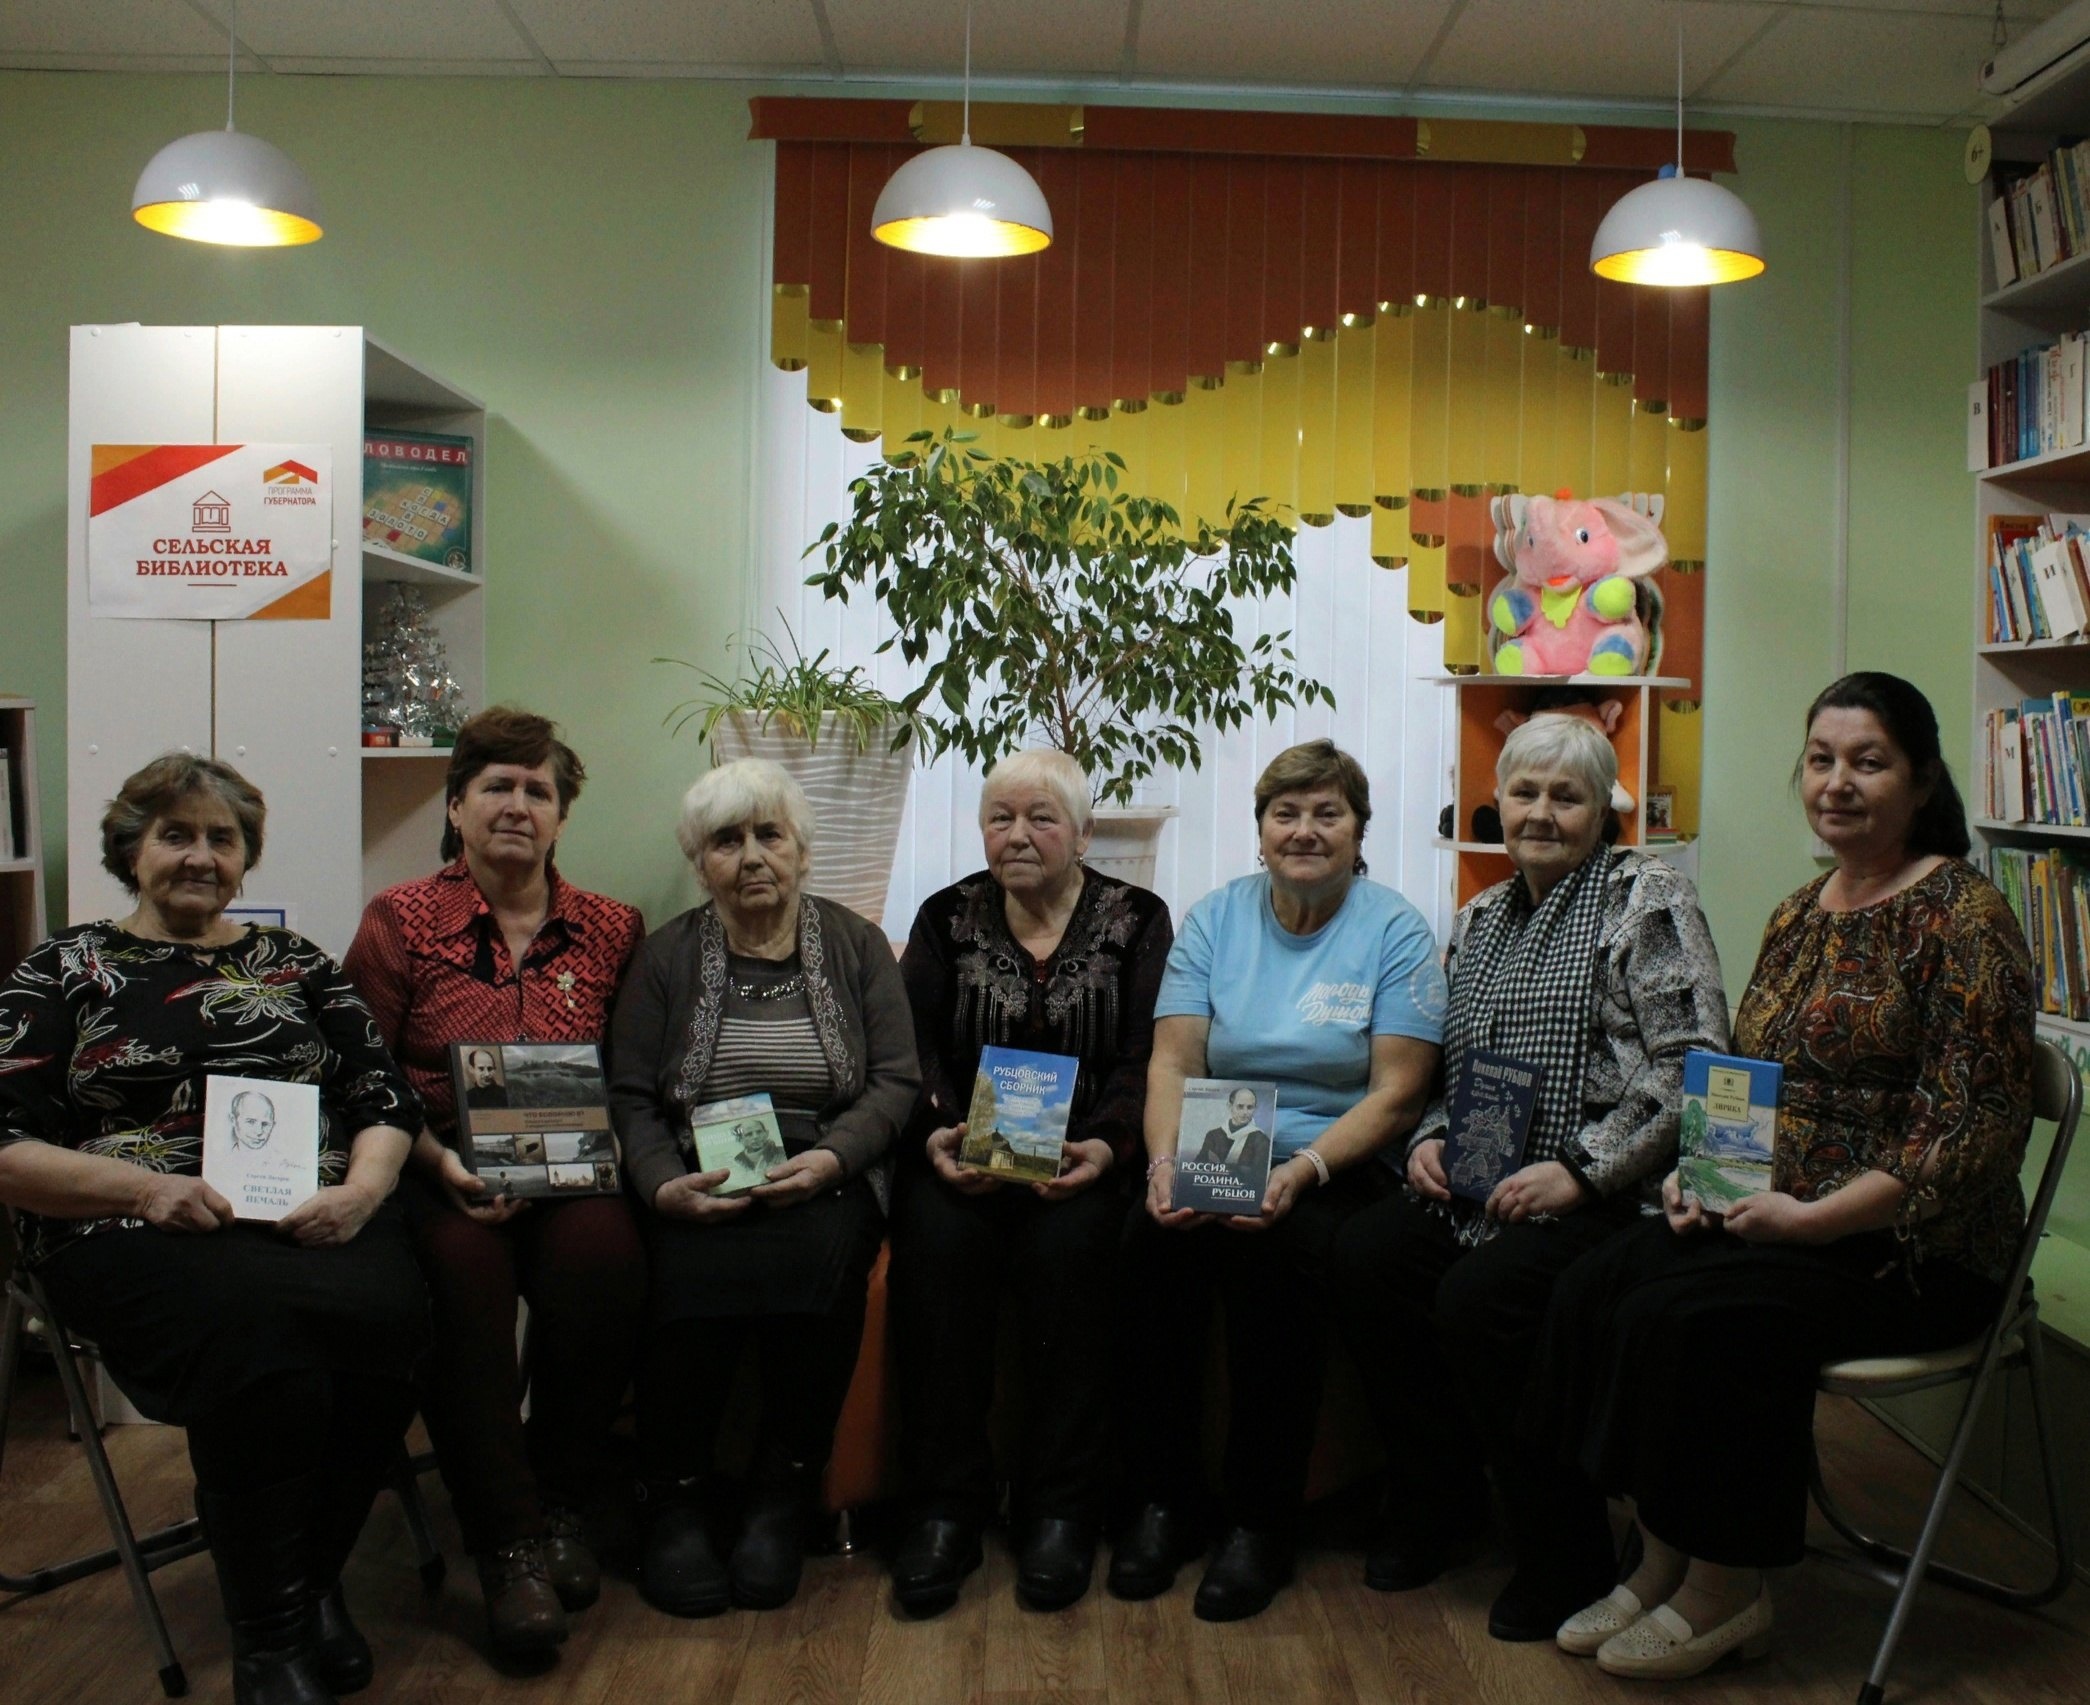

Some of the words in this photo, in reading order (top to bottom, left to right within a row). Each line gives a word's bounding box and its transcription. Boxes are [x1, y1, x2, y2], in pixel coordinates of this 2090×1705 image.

[363, 443, 466, 462] ЛОВОДЕЛ
[268, 486, 313, 496] ПРОГРАММА
[263, 496, 317, 506] ГУБЕРНАТОРА
[152, 538, 271, 555] СЕЛЬСКАЯ
[136, 560, 288, 576] БИБЛИОТЕКА
[2043, 563, 2057, 580] И
[993, 1065, 1058, 1083] РУБЦОВСКИЙ
[1503, 1066, 1533, 1088] РУБЦОВ
[999, 1080, 1047, 1096] СБОРНИК
[1181, 1161, 1229, 1172] РОССИЯ.
[1193, 1174, 1244, 1186] РОДИНА.
[243, 1184, 292, 1196] СВЕТЛАЯ
[1212, 1188, 1256, 1199] РУБЦОВ
[246, 1195, 289, 1206] ПЕЧАЛЬ
